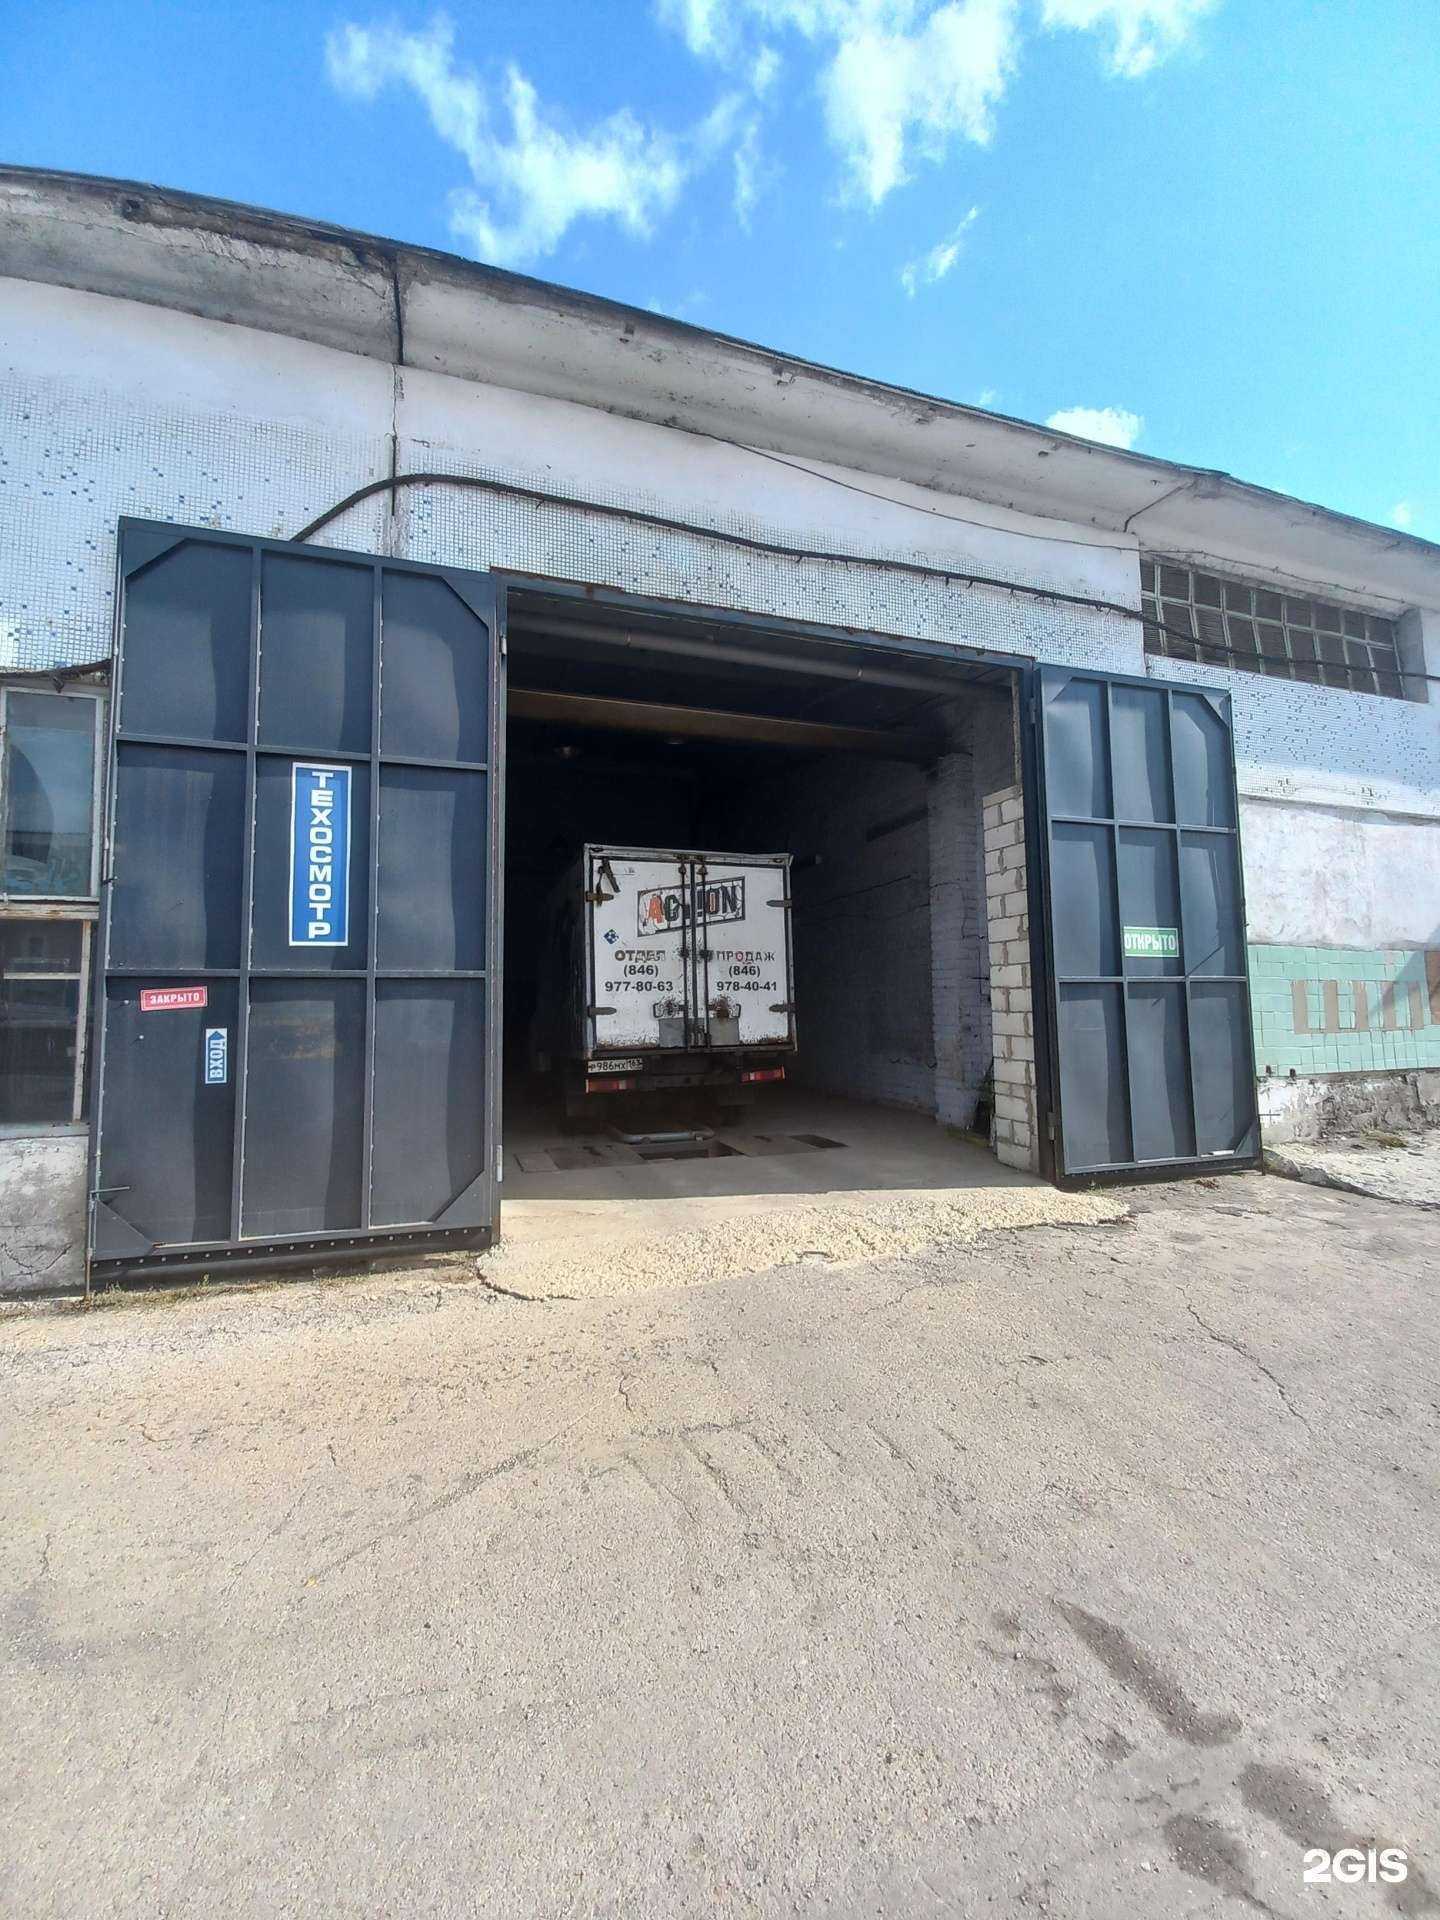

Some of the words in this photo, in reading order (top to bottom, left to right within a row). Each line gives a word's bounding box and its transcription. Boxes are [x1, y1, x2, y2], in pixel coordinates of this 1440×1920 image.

[309, 771, 334, 939] ТЕХОСМОТР
[1124, 933, 1175, 950] ОТКРЫТО
[716, 951, 775, 962] ПРОДАЖ
[624, 965, 658, 977] (846)
[729, 966, 760, 978] (846)
[605, 981, 673, 992] 977-80-63
[717, 981, 777, 992] 978-40-41
[150, 992, 200, 1005] ЗАКРЫТО
[210, 1039, 225, 1078] ВХОД
